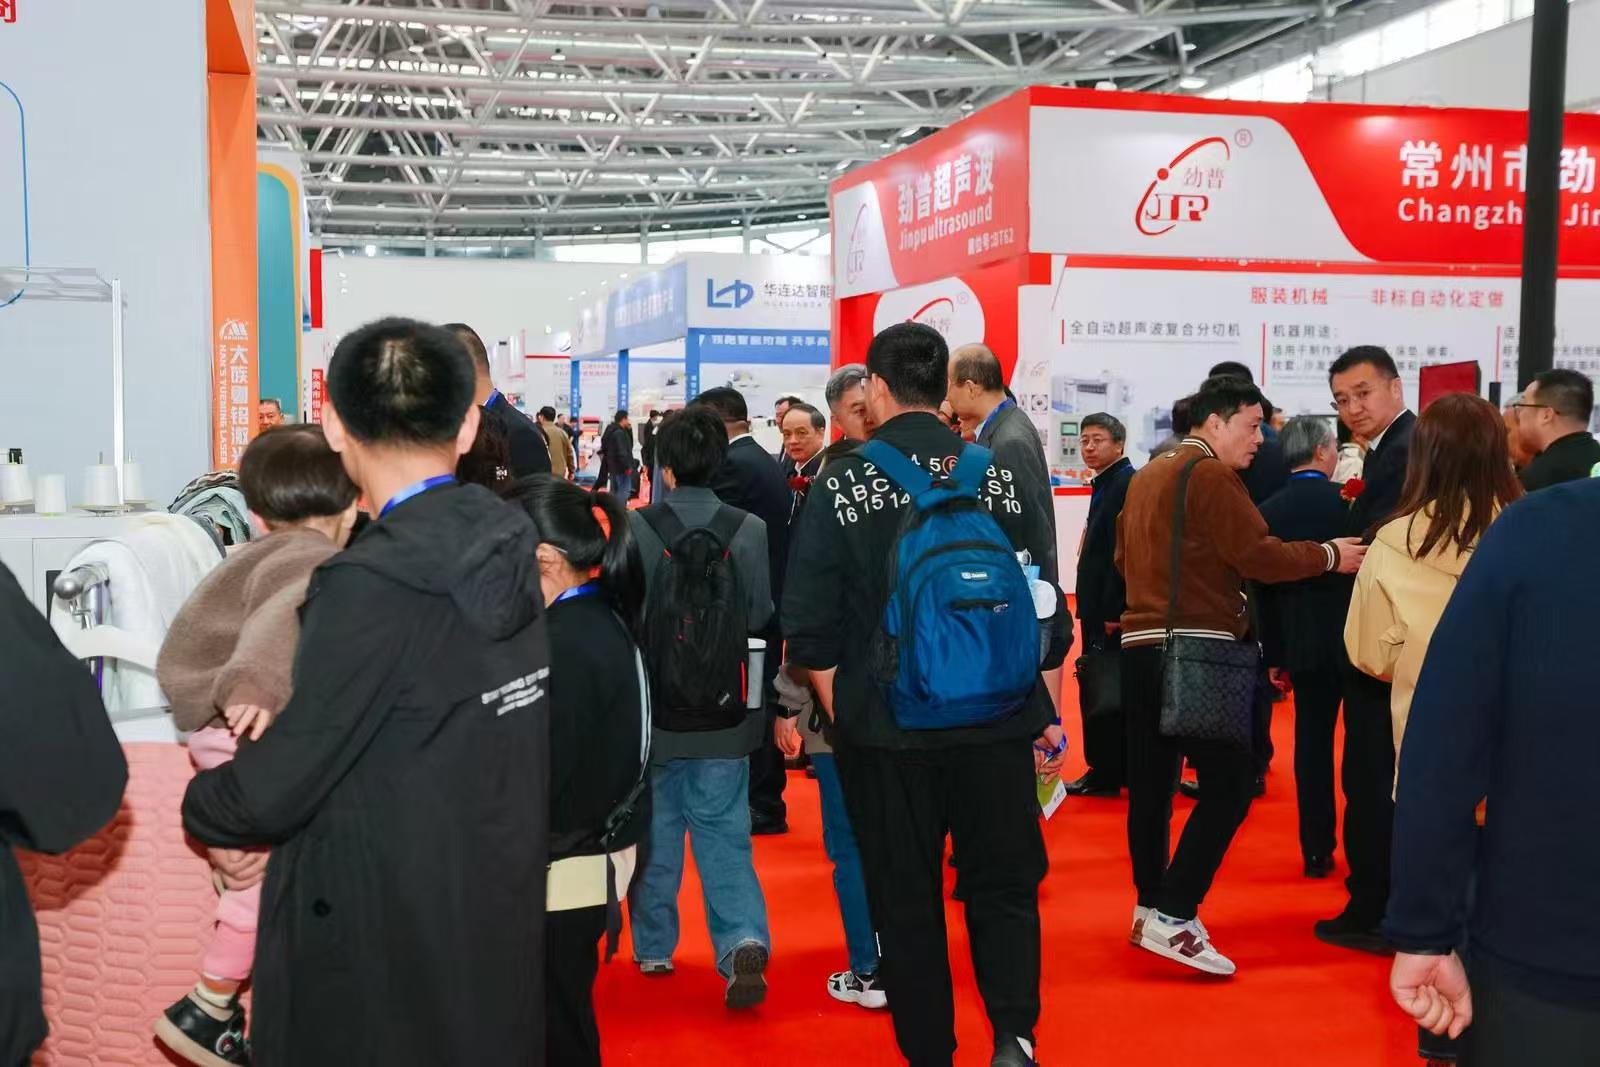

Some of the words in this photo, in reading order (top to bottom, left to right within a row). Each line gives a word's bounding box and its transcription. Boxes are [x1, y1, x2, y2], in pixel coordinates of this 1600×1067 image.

[897, 148, 994, 224] 劲普超声波
[1184, 166, 1225, 189] 劲普
[898, 197, 993, 251] Jinpuultrasound
[1398, 197, 1523, 230] Changzh
[763, 282, 831, 299] 华连达智能
[1251, 286, 1328, 305] 服装机械
[1071, 320, 1241, 337] 全自动超声波复合分切机
[845, 469, 856, 483] 1
[863, 462, 877, 476] 2
[929, 458, 940, 472] 5
[1000, 469, 1013, 482] 9
[834, 493, 850, 509] A
[852, 485, 868, 502] B
[872, 478, 890, 492] C
[988, 480, 1003, 495] S
[1005, 485, 1015, 498] J
[836, 507, 858, 526] 16
[863, 494, 883, 514] 15
[1002, 499, 1022, 514] 10
